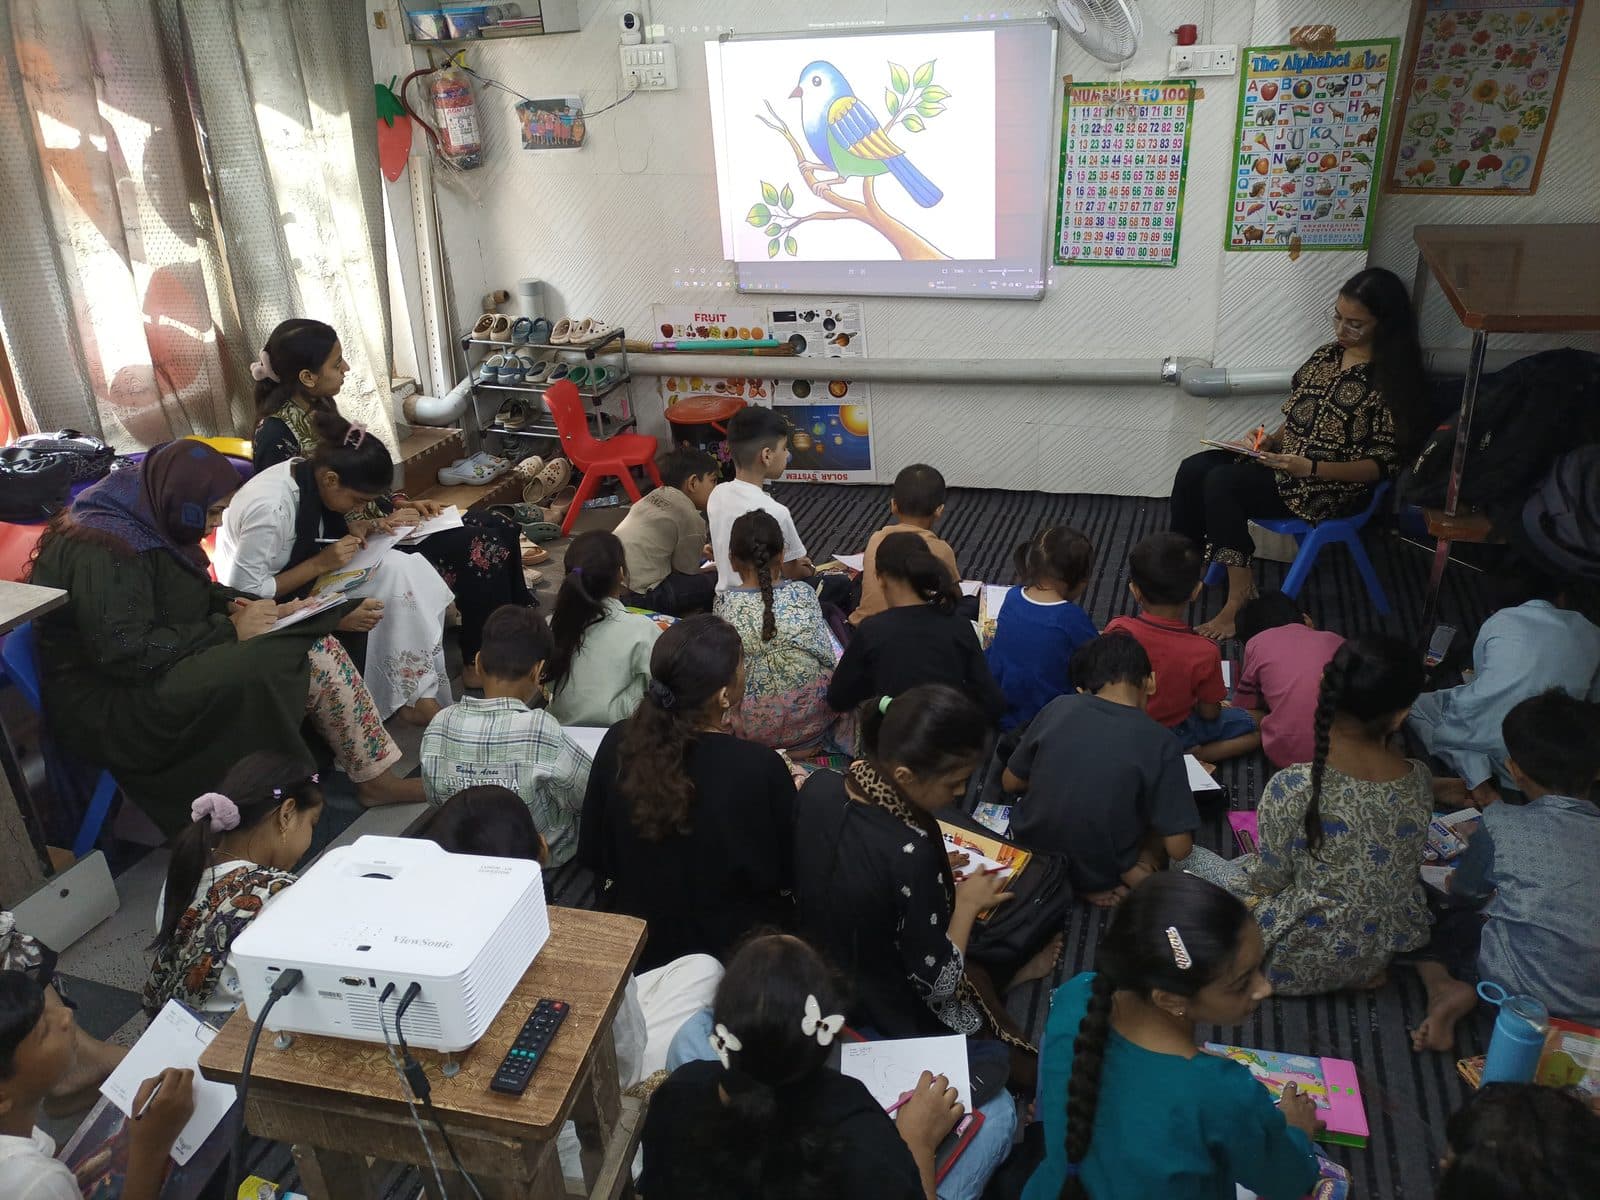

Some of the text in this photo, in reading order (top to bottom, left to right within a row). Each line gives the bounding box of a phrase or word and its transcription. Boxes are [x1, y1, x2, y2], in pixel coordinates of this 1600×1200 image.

[1252, 56, 1278, 72] The
[1282, 50, 1351, 74] Alphabet
[1248, 75, 1362, 92] A B C D
[1142, 88, 1160, 101] TO
[1163, 88, 1186, 101] 100
[1082, 107, 1090, 117] 11
[1093, 107, 1102, 118] 21
[1139, 106, 1148, 117] 61
[1152, 106, 1160, 116] 71
[1164, 106, 1172, 116] 81
[1177, 106, 1185, 116] 91
[1244, 100, 1359, 116] E F G H
[1071, 124, 1076, 133] 2
[1081, 124, 1089, 133] 12
[1092, 123, 1101, 133] 22
[1115, 123, 1124, 133] 42
[1126, 122, 1135, 133] 52
[1138, 123, 1147, 133] 62
[1150, 123, 1159, 132] 72
[1162, 122, 1171, 132] 82
[1175, 122, 1184, 132] 92
[1242, 126, 1353, 140] I J K L
[1070, 138, 1182, 149] 3 13 23 33 43 53 63 73 83 93
[1068, 155, 1180, 165] 4 14 24 34 44 54 64 74 84 94
[1240, 151, 1350, 164] M N O P
[1068, 171, 1178, 181] 5 15 25 35 45 55 65 75 85 95
[1238, 175, 1349, 189] Q R S T
[1067, 186, 1177, 196] 6 16 26 36 46 56 66 76 86 96
[1066, 201, 1176, 211] 7 17 27 37 47 57 67 77 87 97
[1236, 199, 1345, 212] U V W X
[1065, 216, 1174, 226] 8 18 28 38 48 58 68 78 88 98
[1234, 224, 1275, 234] Y Z
[1064, 231, 1172, 242] 9 19 29 39 49 59 69 79 89 99
[1061, 246, 1171, 257] 10 20 30 40 50 60 70 80 90 100
[694, 312, 726, 322] FRUIT
[393, 936, 453, 949] ViewSonic
